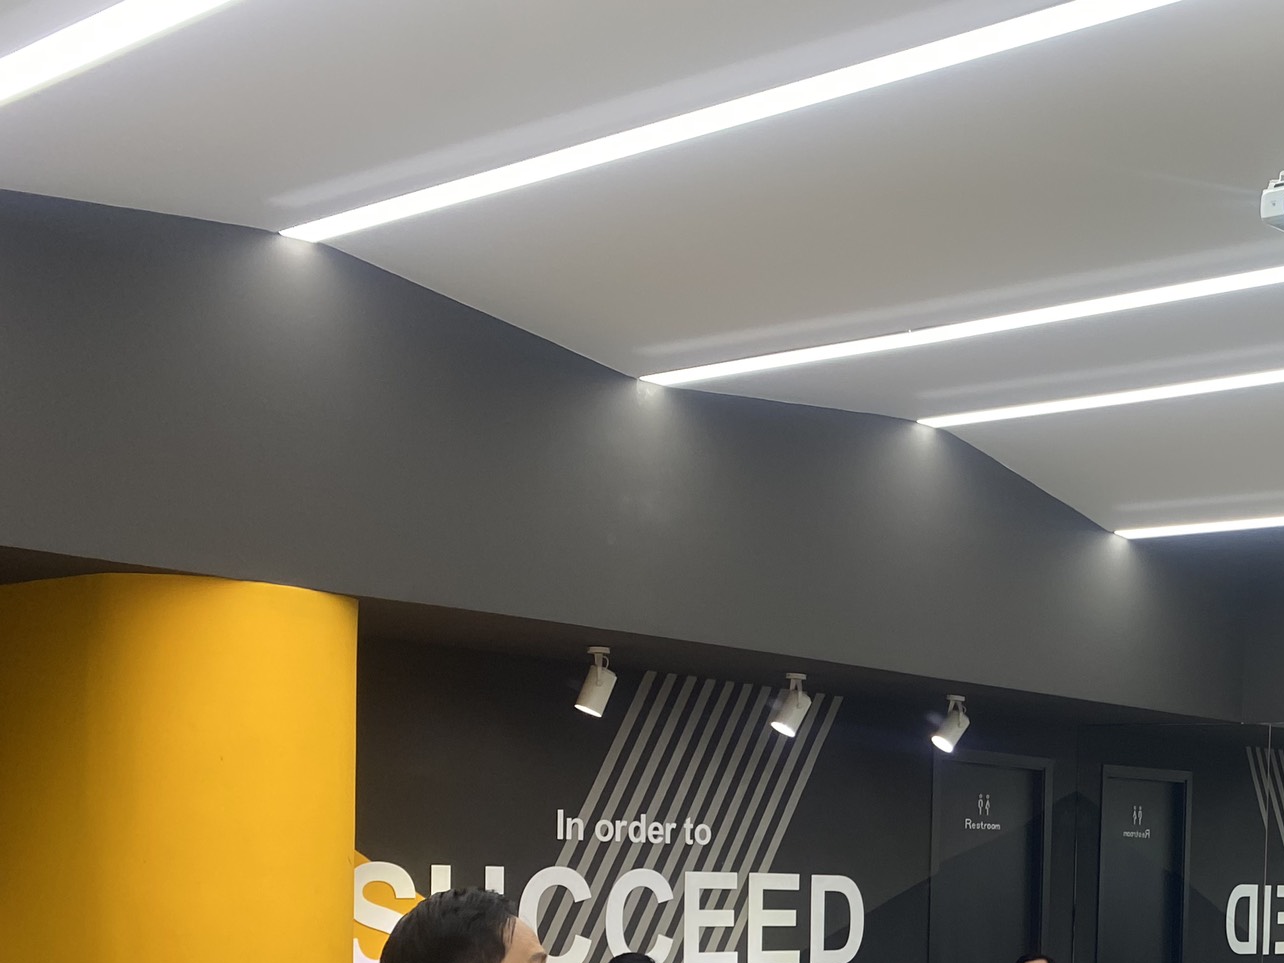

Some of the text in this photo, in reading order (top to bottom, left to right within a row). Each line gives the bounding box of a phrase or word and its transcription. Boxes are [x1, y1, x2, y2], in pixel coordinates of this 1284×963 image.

[556, 809, 713, 846] In order to
[965, 818, 1001, 830] Restroom
